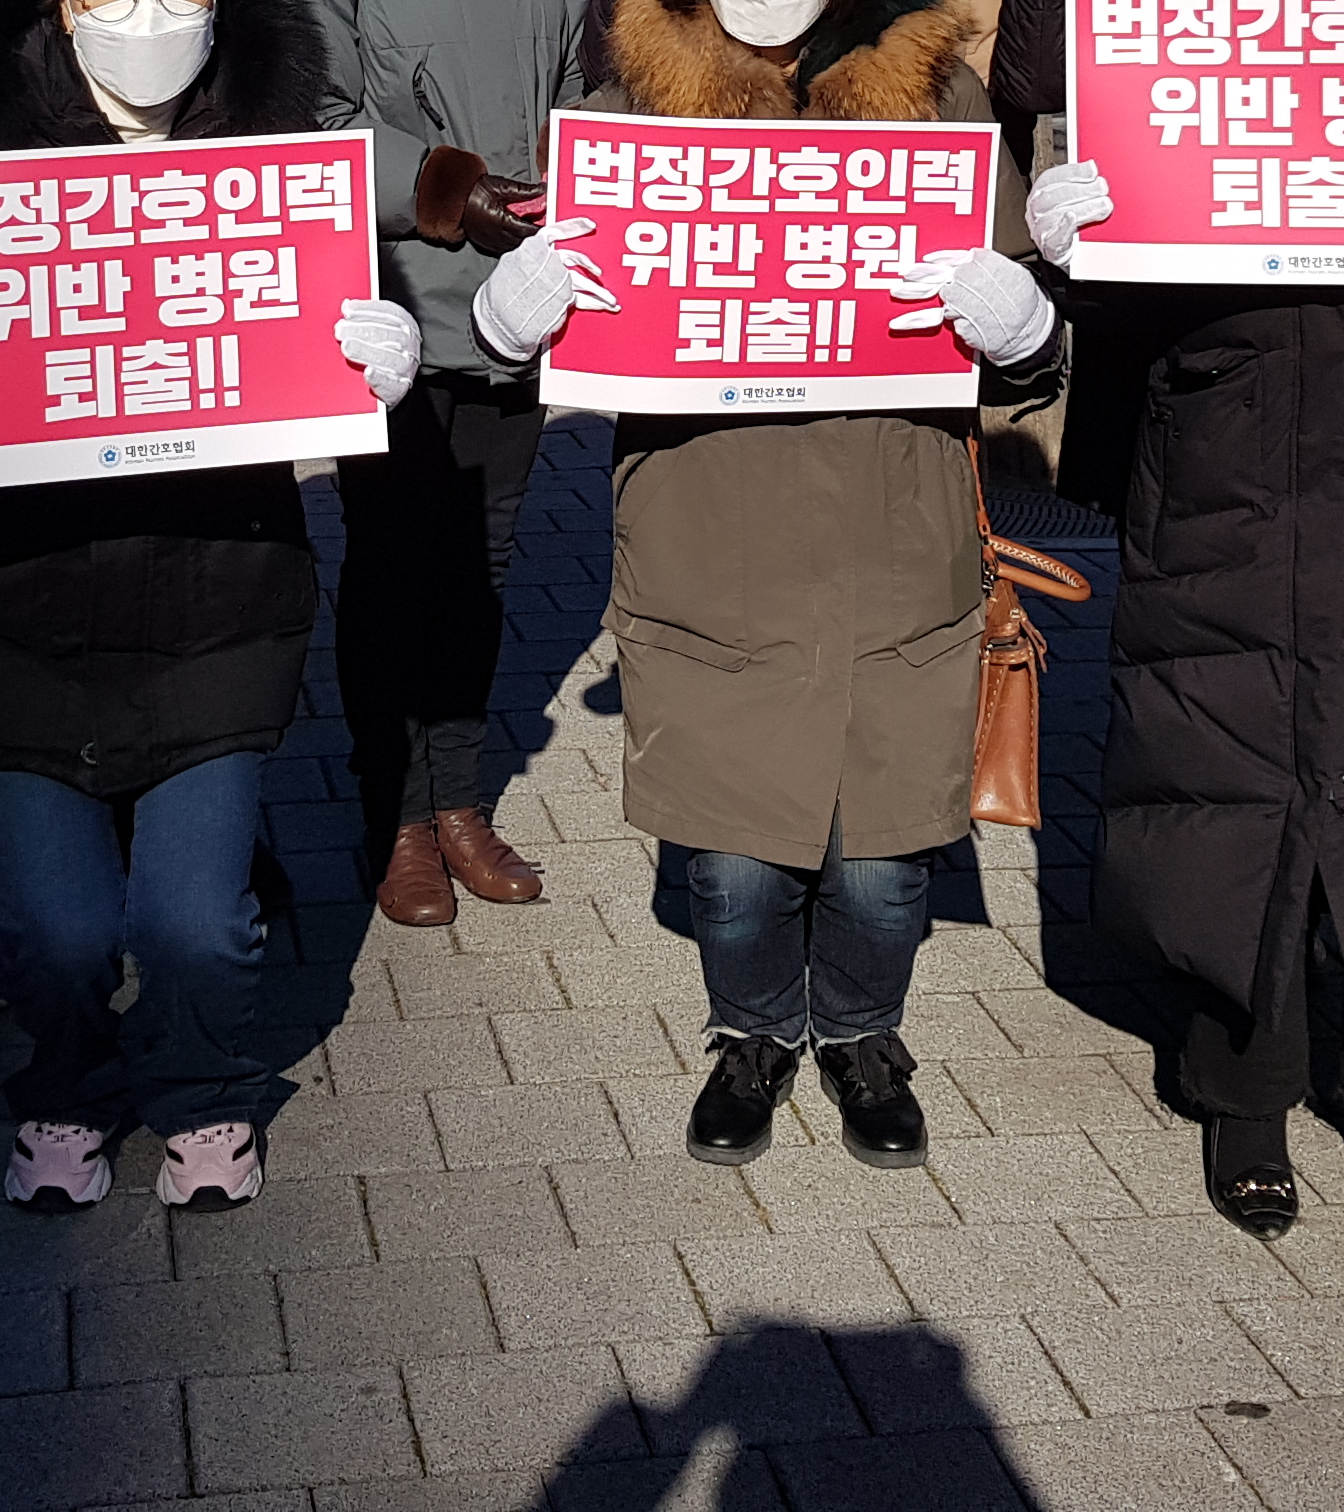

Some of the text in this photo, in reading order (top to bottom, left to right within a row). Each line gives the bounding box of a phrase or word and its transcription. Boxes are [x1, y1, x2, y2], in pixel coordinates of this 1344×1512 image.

[1148, 75, 1299, 148] 위반
[572, 139, 977, 216] 법정간호인력
[153, 246, 299, 328] 병원
[621, 221, 919, 290] 위반 병원
[674, 298, 857, 364] 퇴출!!
[44, 334, 241, 424] 퇴출!!
[743, 386, 806, 399] 대한간호협회
[125, 439, 196, 458] 대한간호협회
